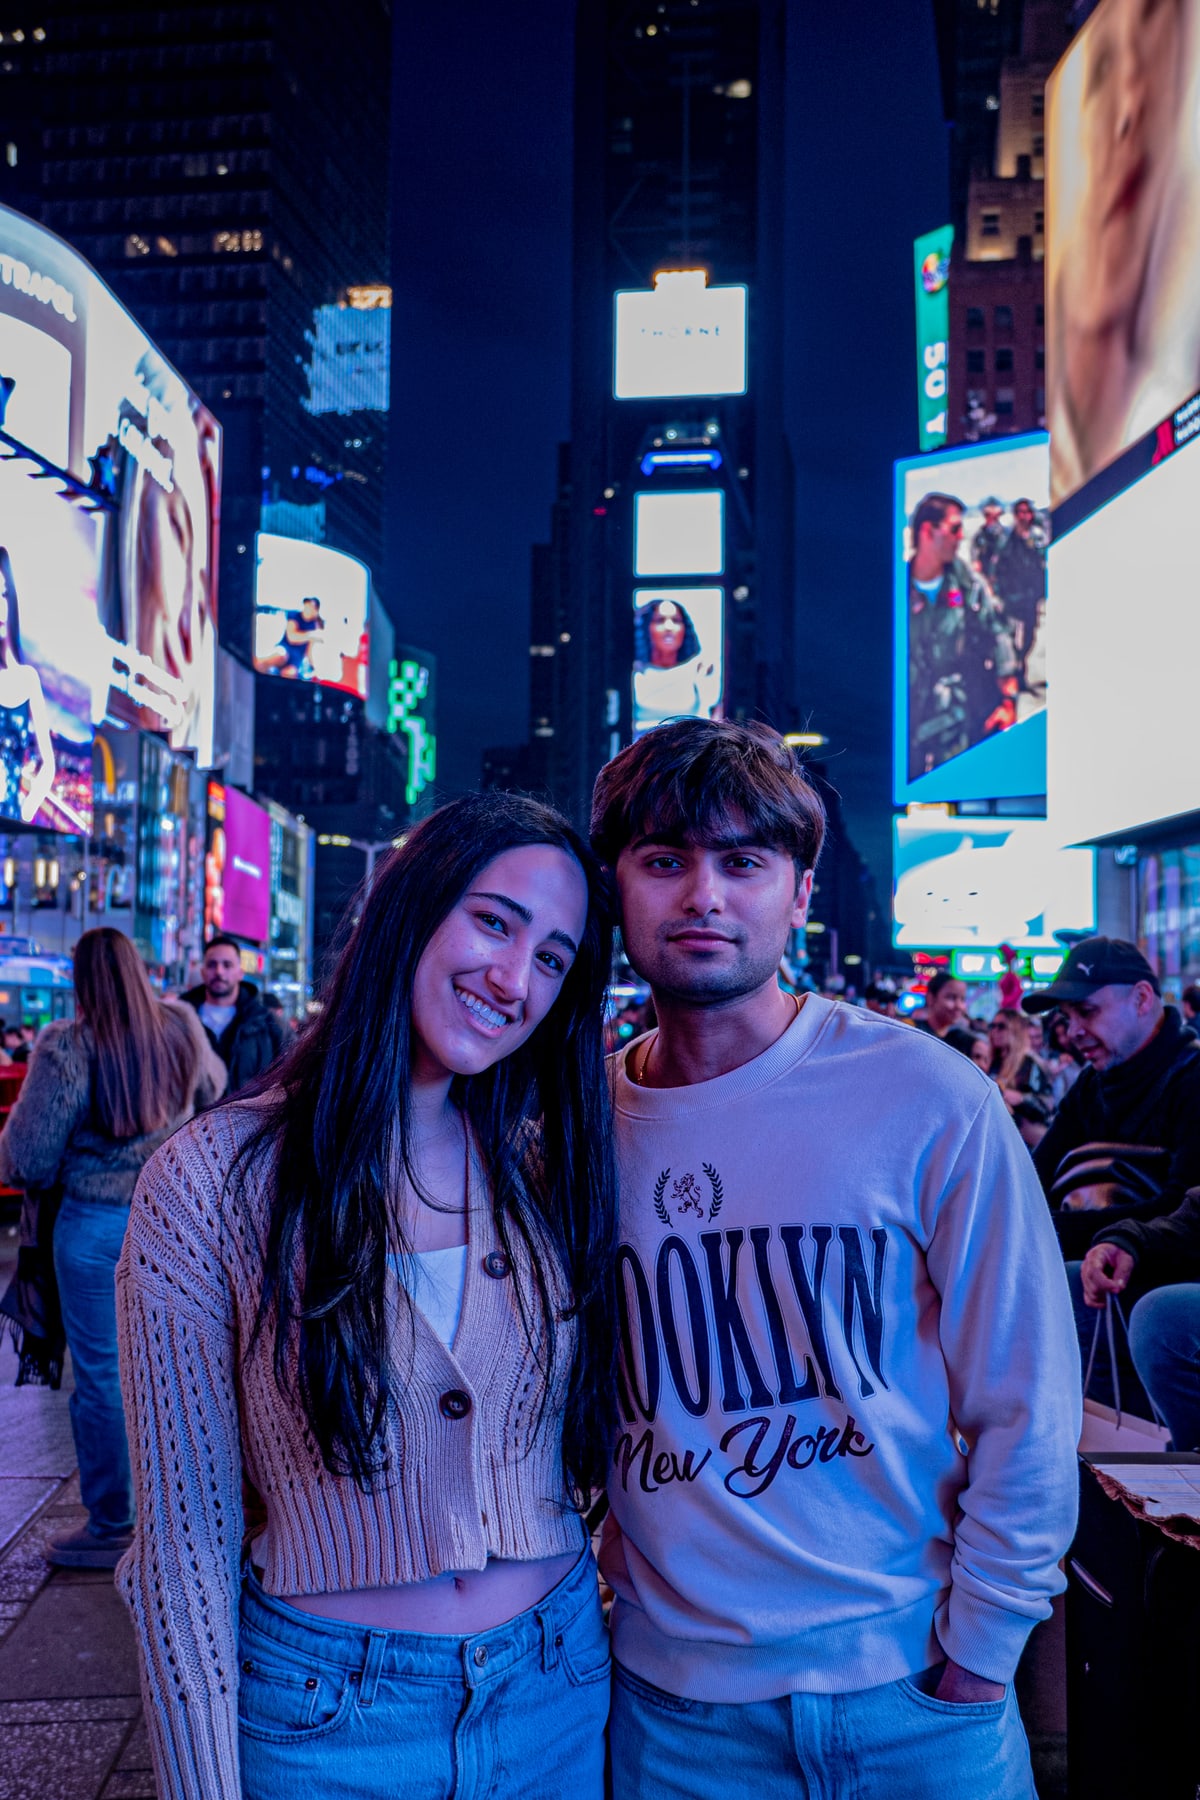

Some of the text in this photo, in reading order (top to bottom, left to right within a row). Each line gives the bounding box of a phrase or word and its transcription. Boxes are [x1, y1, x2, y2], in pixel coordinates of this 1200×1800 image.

[615, 1223, 890, 1425] OOKLYN
[614, 1414, 875, 1499] New York
